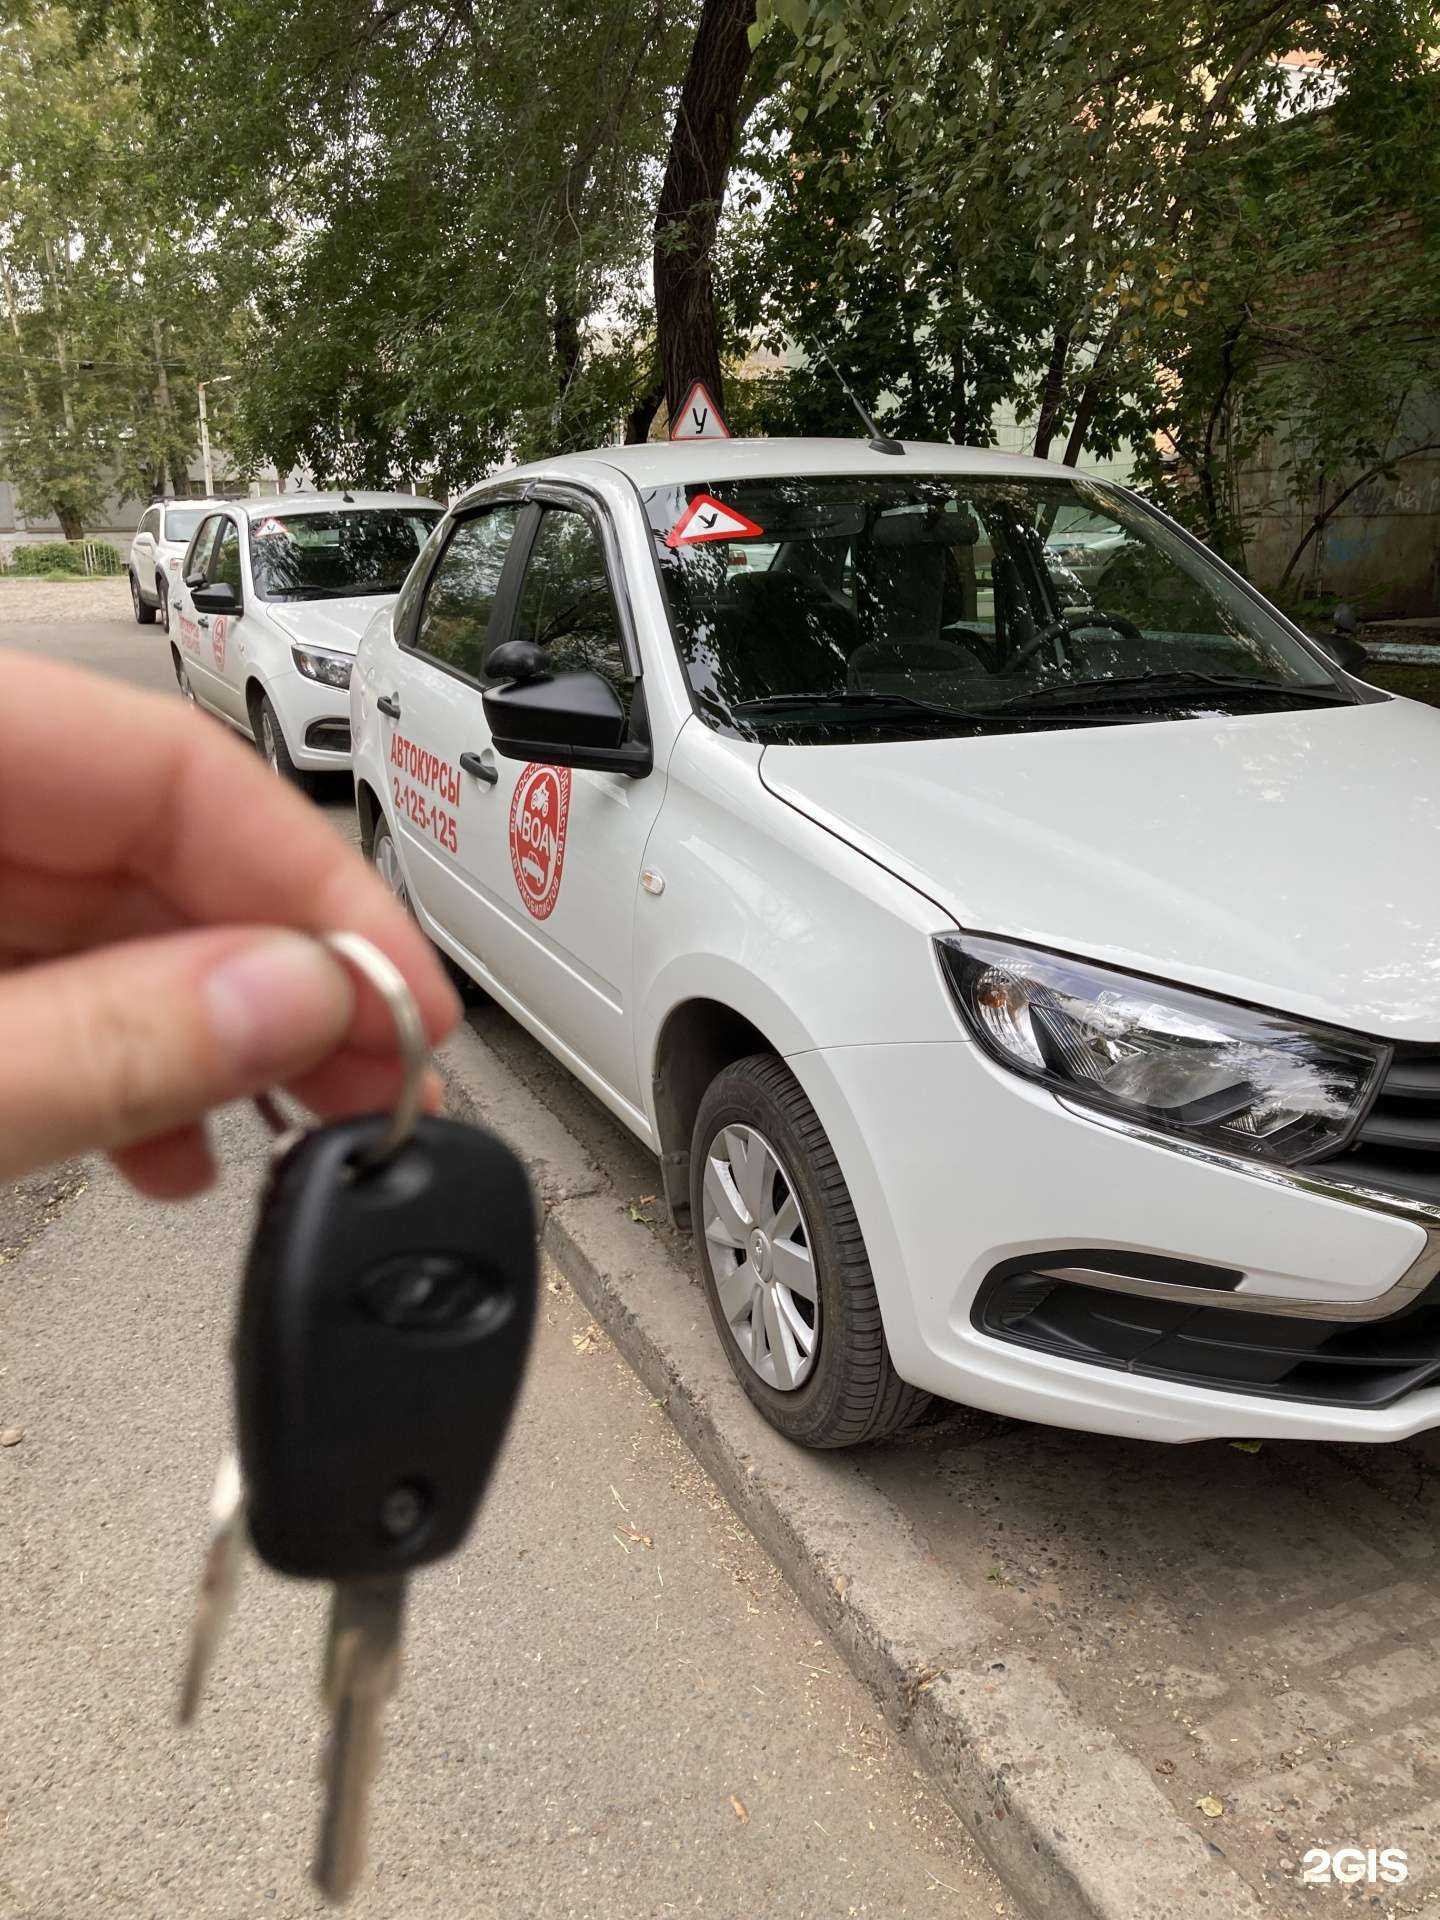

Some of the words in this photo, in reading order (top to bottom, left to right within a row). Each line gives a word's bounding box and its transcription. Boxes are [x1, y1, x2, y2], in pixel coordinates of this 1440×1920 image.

[692, 408, 708, 434] У
[698, 512, 718, 529] У
[391, 733, 461, 808] АВТОКУРСЫ
[393, 776, 458, 854] 2-125-125
[521, 810, 550, 857] ВОА
